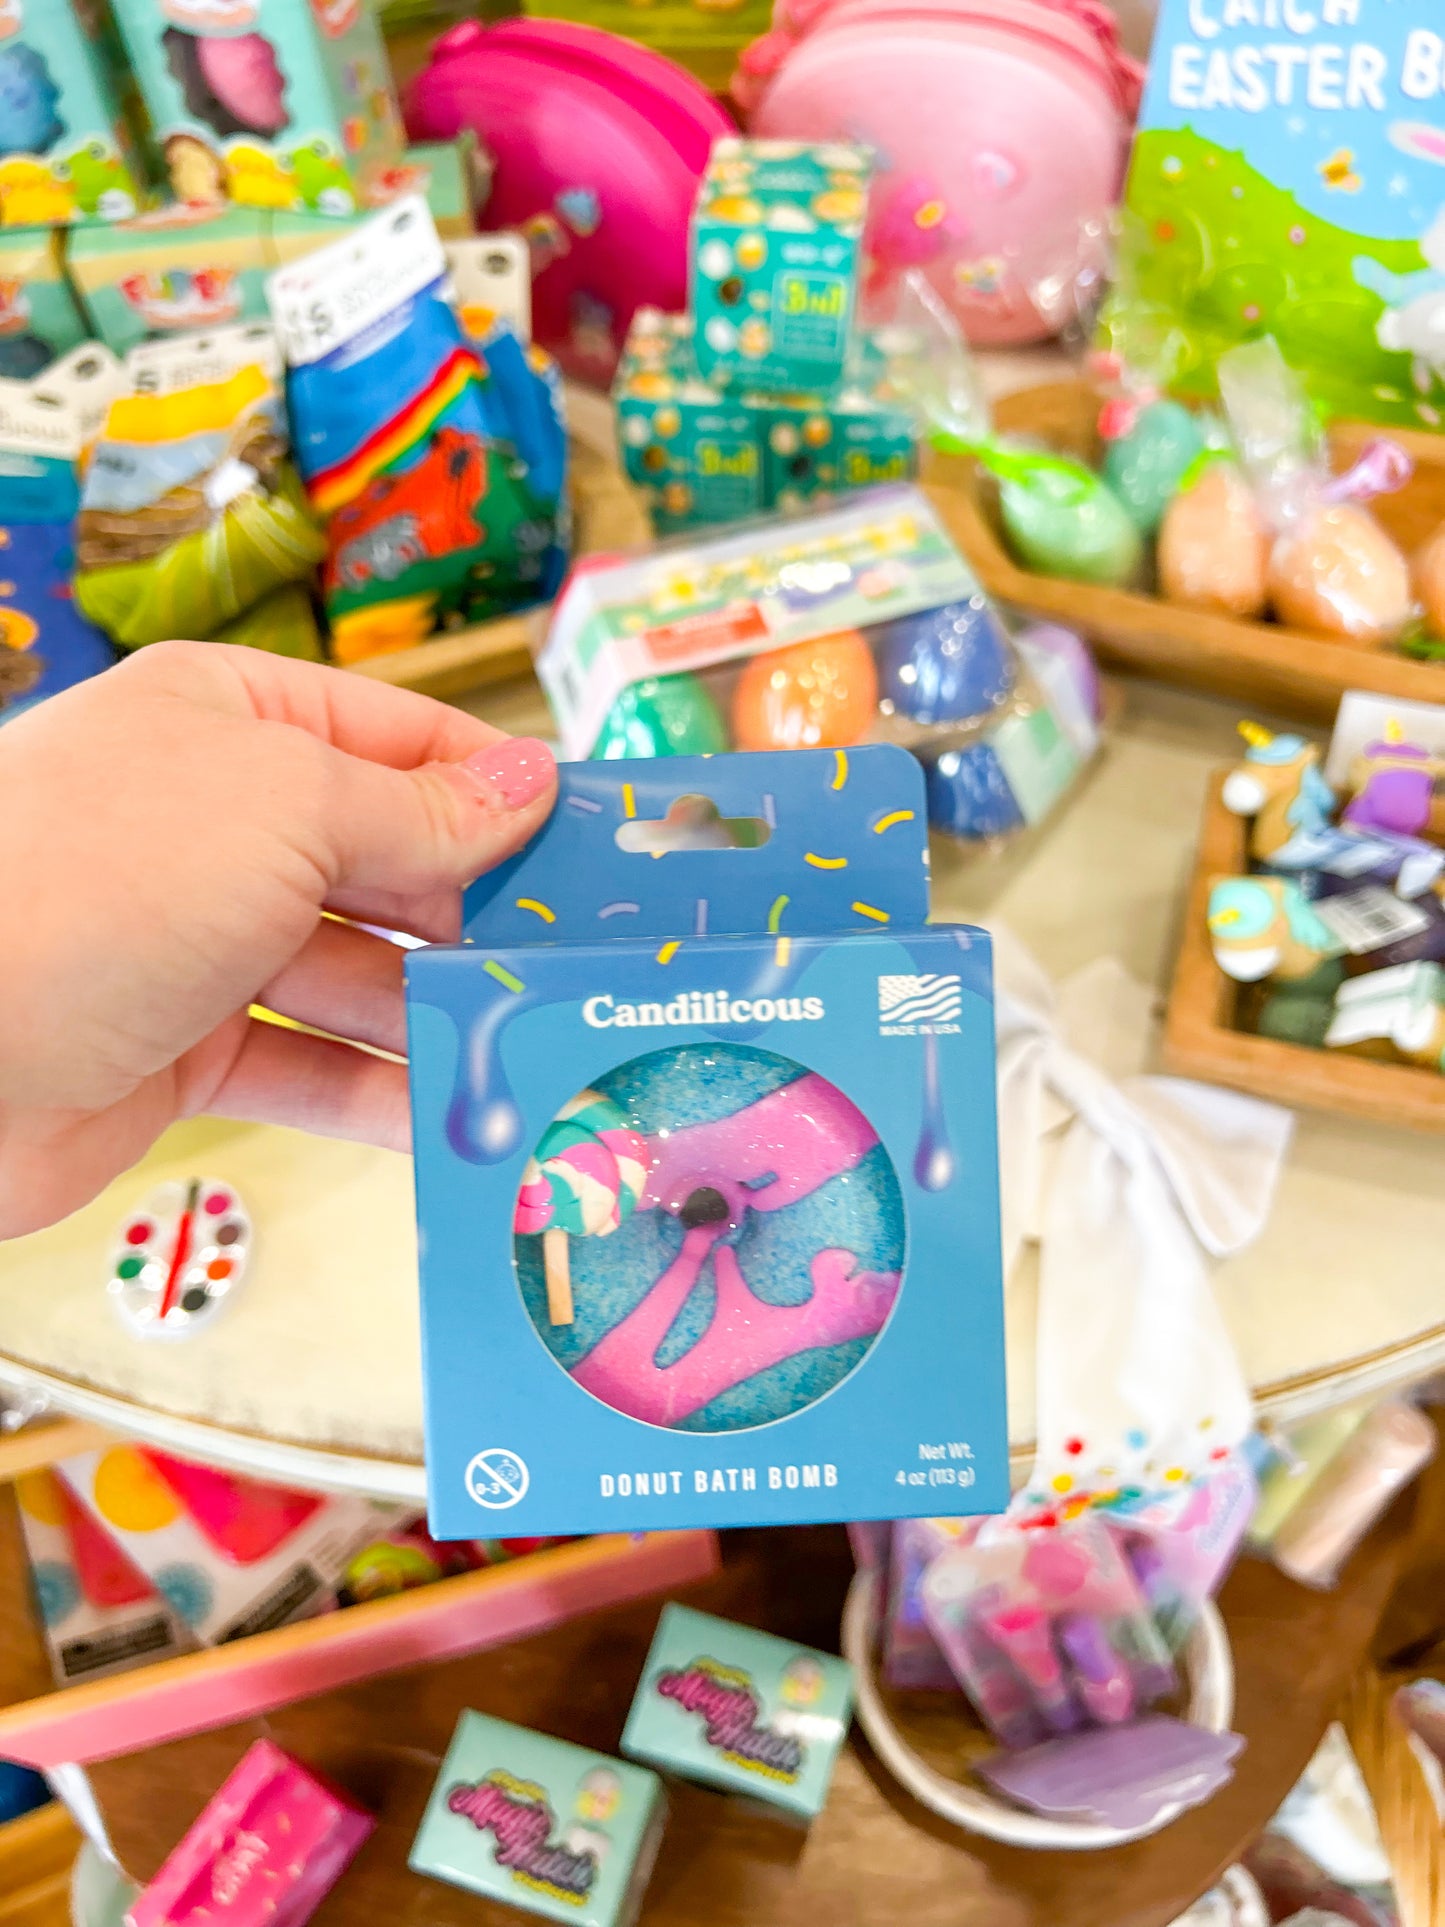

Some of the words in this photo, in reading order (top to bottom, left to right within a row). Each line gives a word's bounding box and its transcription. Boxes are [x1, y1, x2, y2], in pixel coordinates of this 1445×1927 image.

[1168, 43, 1387, 112] EASTER
[582, 990, 825, 1028] Candilicous
[879, 1025, 917, 1036] MADE
[918, 1025, 933, 1035] IN
[934, 1024, 962, 1035] USA
[918, 1443, 946, 1460] Net
[947, 1442, 975, 1459] Wt.
[600, 1470, 683, 1498] DONUT
[694, 1467, 757, 1494] BATH
[768, 1463, 839, 1489] BOMB
[894, 1469, 906, 1486] 4
[907, 1471, 928, 1486] oz
[957, 1466, 976, 1488] g)
[475, 1482, 501, 1496] 0-3
